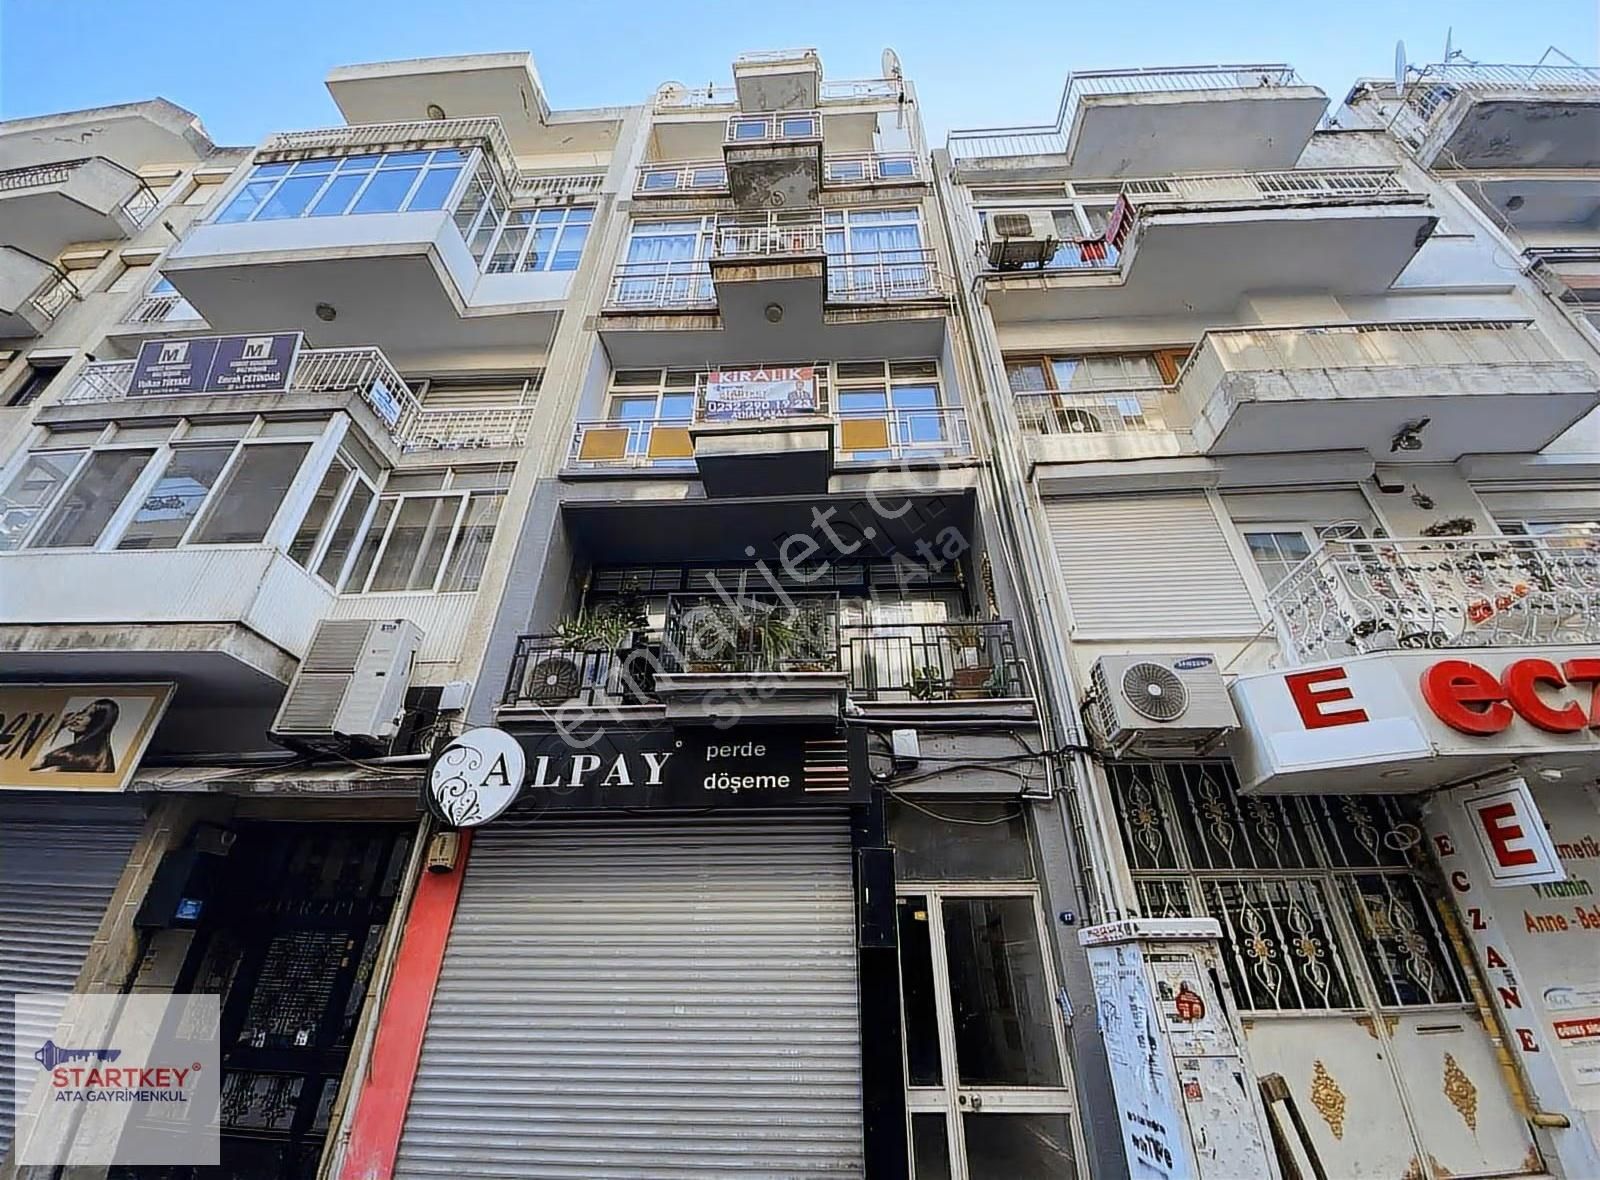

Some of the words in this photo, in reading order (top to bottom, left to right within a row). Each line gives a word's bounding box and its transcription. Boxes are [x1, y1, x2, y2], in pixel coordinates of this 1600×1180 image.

[245, 344, 264, 357] M
[1284, 667, 1369, 730] E
[705, 741, 767, 761] perde
[479, 751, 673, 788] ALPAY
[703, 771, 791, 793] döşeme
[1477, 802, 1538, 867] E
[1555, 834, 1600, 861] metik
[1523, 909, 1569, 934] Anne
